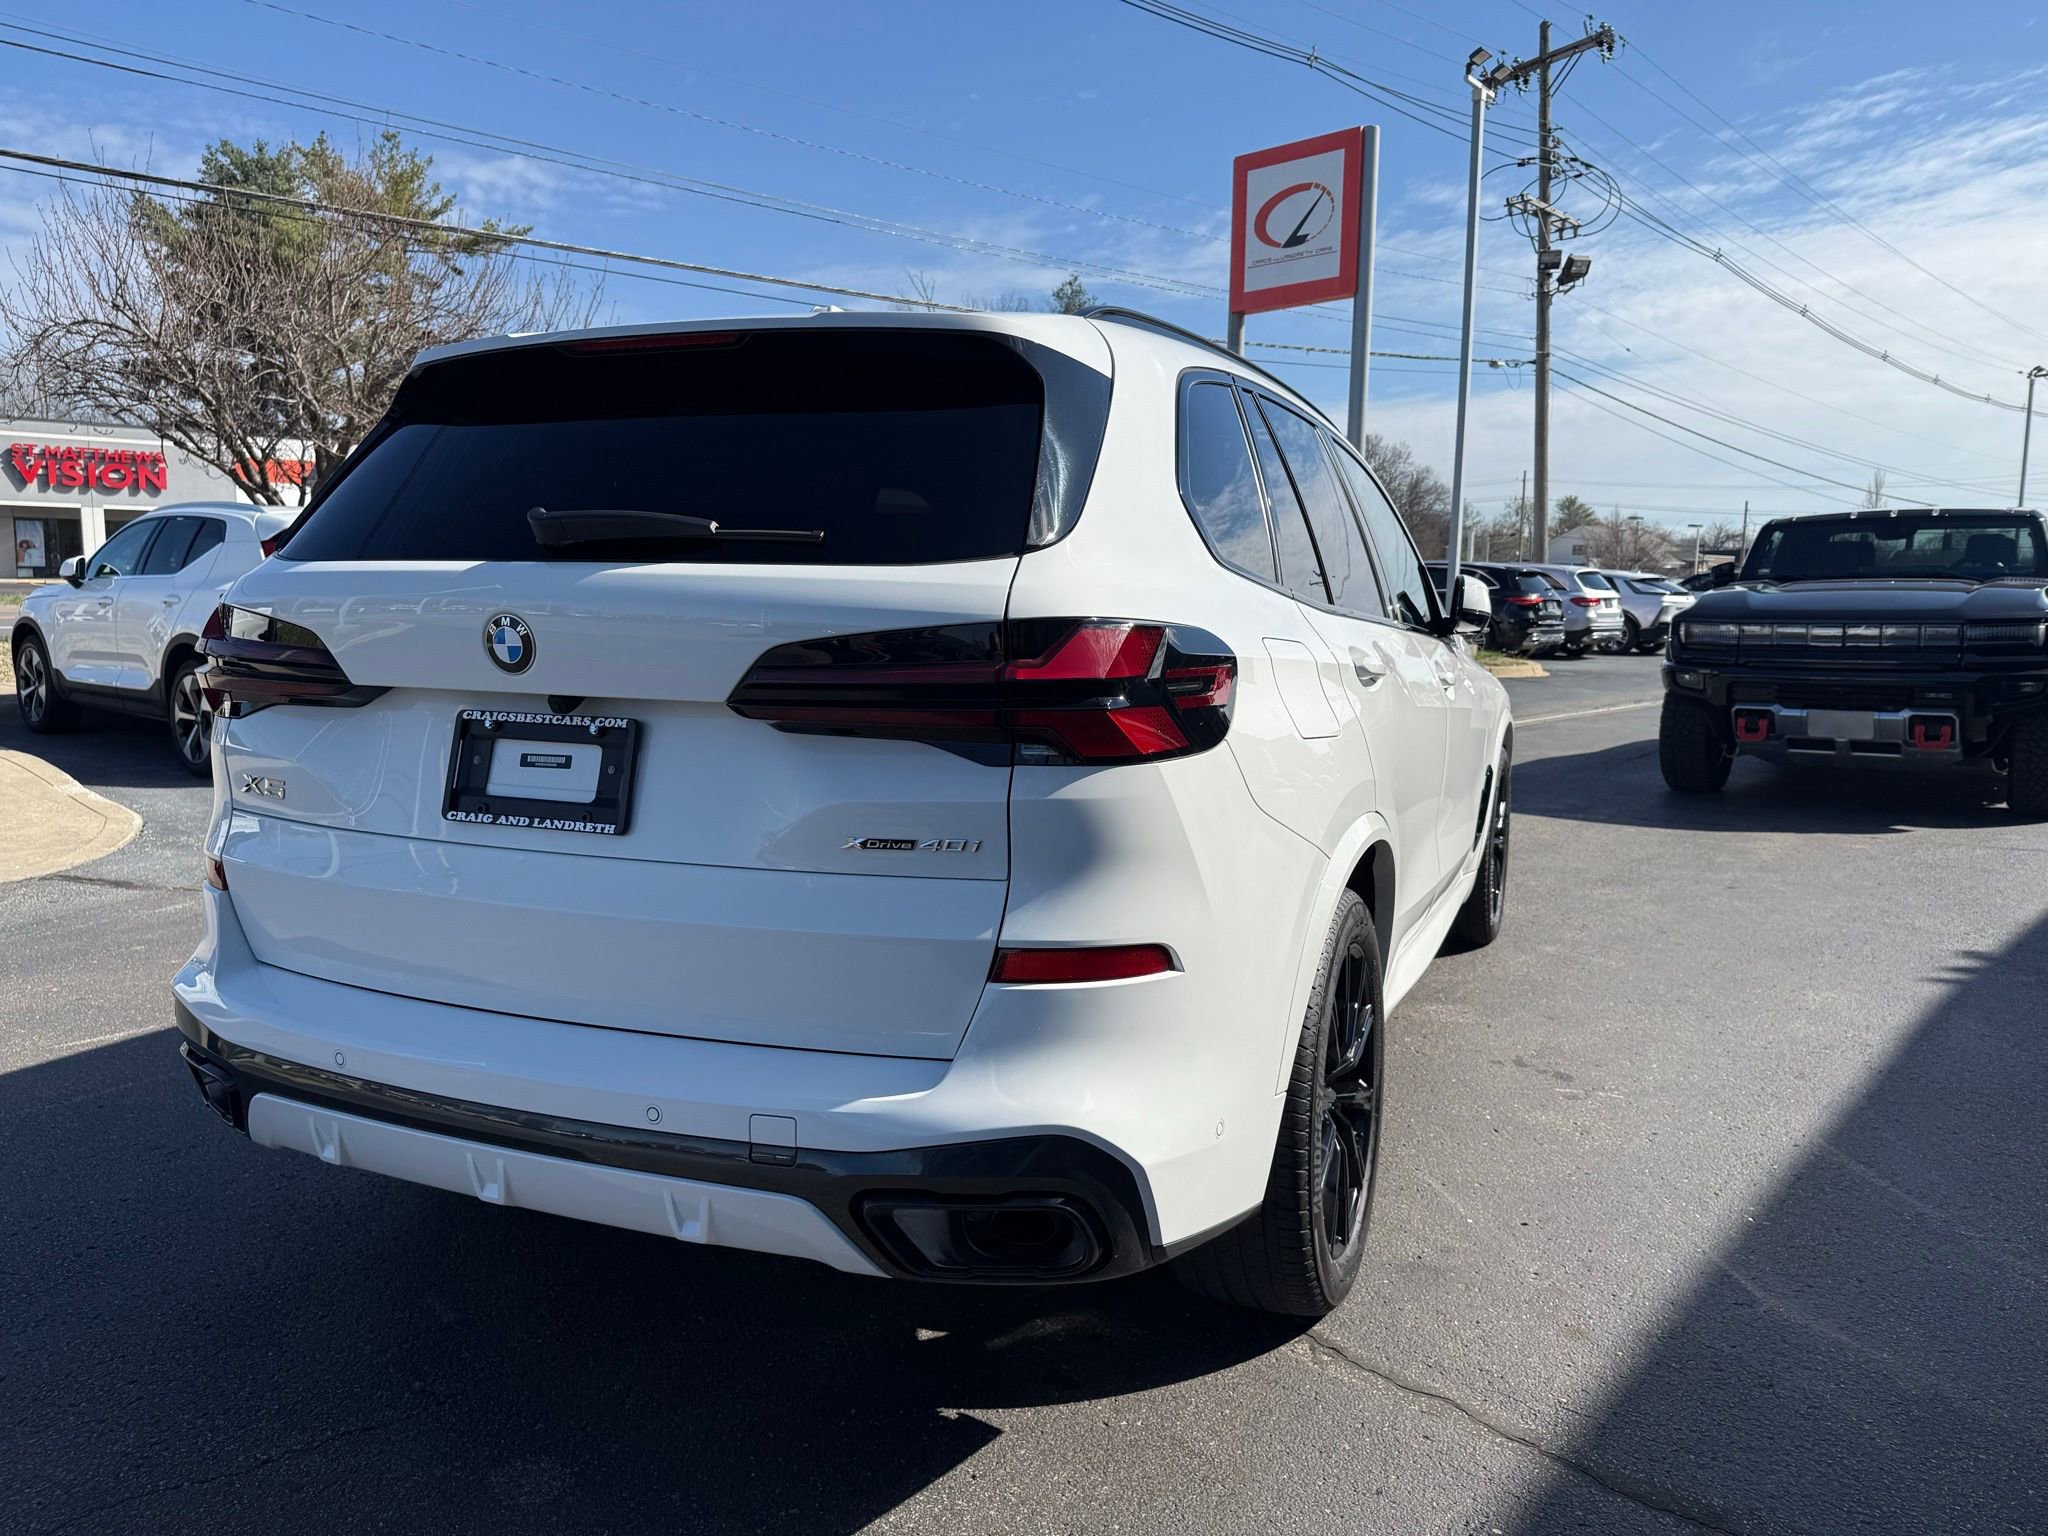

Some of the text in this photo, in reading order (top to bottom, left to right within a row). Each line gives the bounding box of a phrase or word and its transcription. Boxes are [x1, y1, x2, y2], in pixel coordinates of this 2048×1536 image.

[44, 445, 167, 465] MATTHEWS
[12, 457, 168, 491] VISION
[488, 616, 528, 636] BMW
[462, 710, 629, 729] CRAIGSBESTCARS.COM
[240, 773, 286, 801] X5
[446, 810, 616, 835] CRAIG AND LANDRETH
[919, 838, 983, 854] 40i
